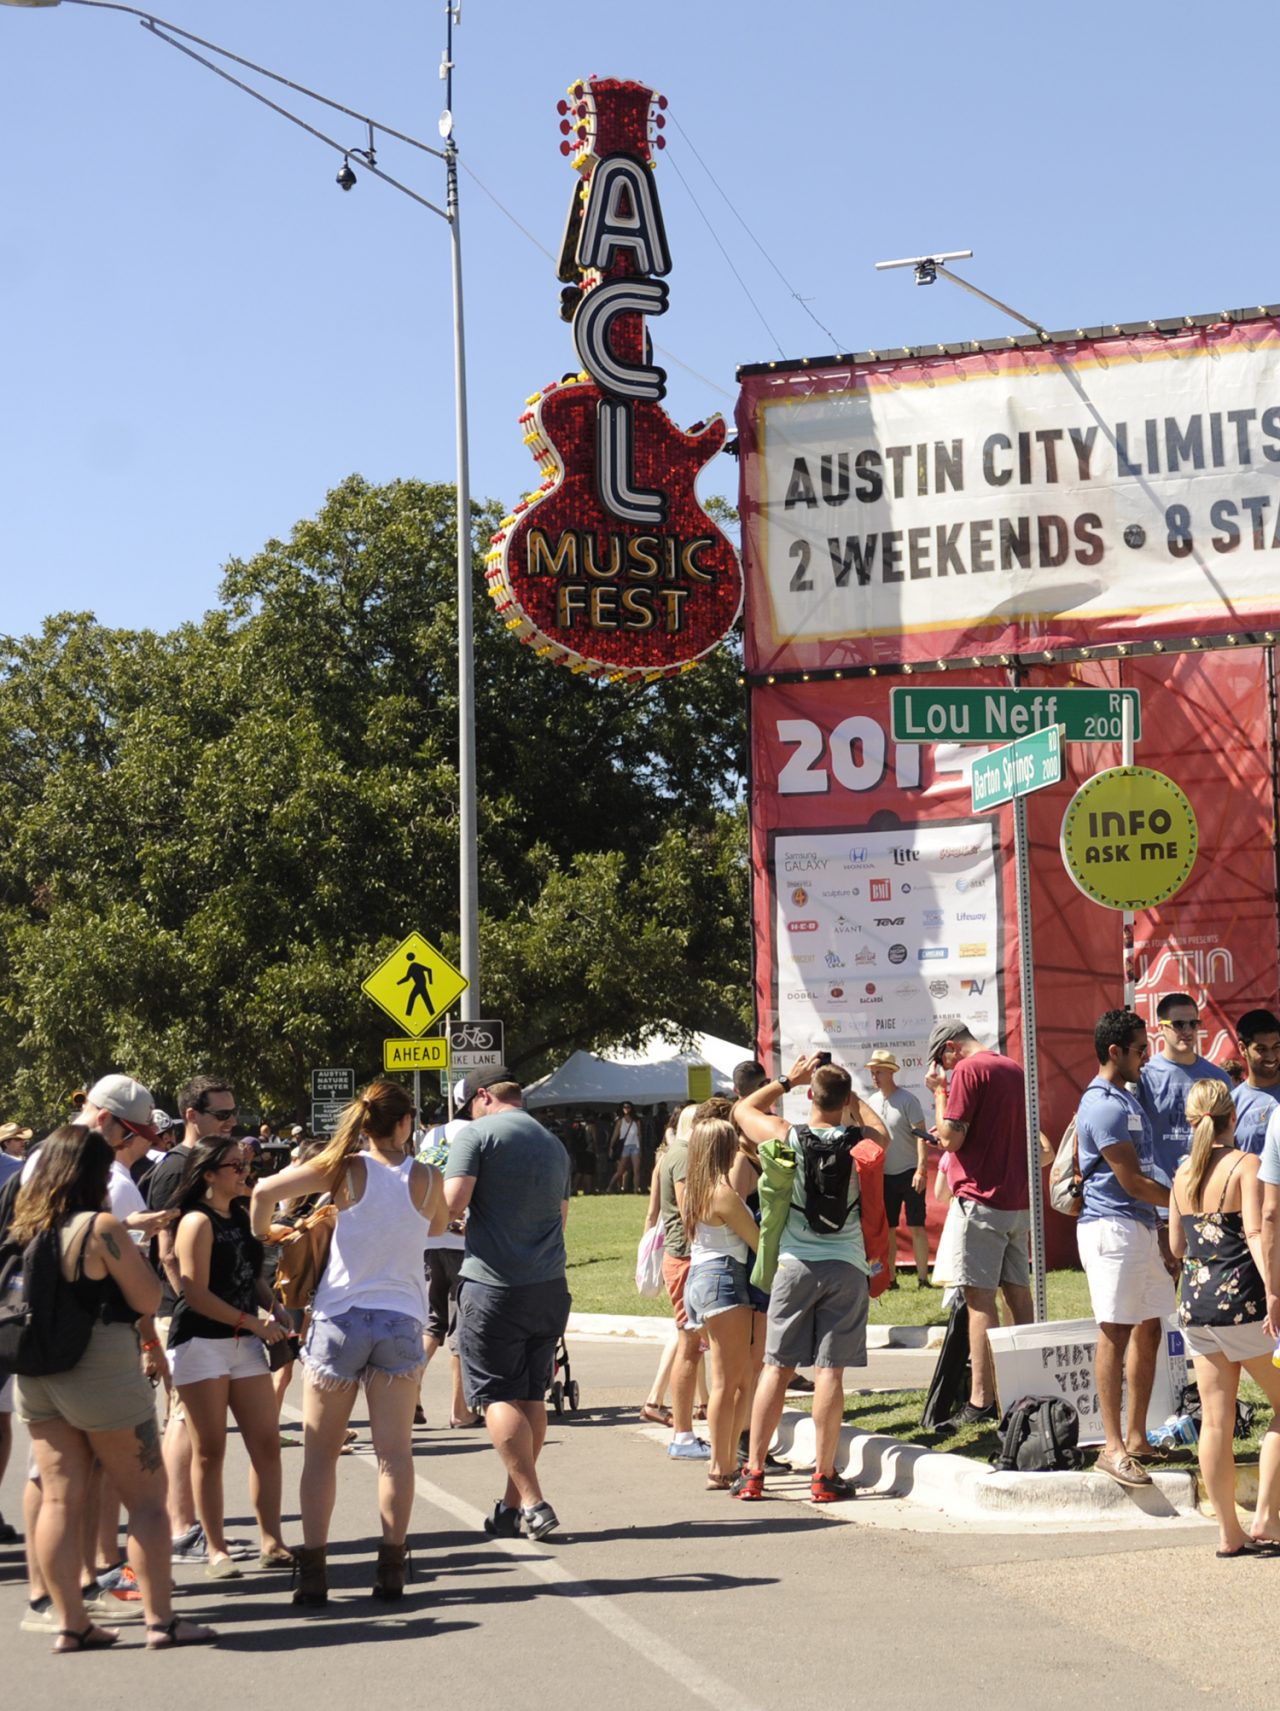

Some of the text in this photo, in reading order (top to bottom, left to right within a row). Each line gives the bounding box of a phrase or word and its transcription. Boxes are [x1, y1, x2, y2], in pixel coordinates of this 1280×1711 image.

[784, 438, 965, 511] AUSTIN
[982, 425, 1100, 487] CITY
[526, 526, 714, 583] MUSIC
[788, 539, 814, 593] 2
[827, 513, 1105, 588] WEEKENDS
[1164, 504, 1194, 559] 8
[558, 584, 690, 632] FEST
[904, 693, 1133, 734] Lou Neff R
[974, 731, 1057, 801] Barton Springs RD
[1042, 755, 1058, 780] 2000
[1089, 808, 1172, 838] INFO
[784, 851, 817, 861] Samsung
[1085, 841, 1178, 864] ASK ME
[784, 860, 828, 872] GALAXY
[834, 925, 862, 934] AVANT
[875, 1018, 896, 1030] PAIGE
[393, 1046, 441, 1062] AHEAD
[452, 1054, 497, 1065] IKE LANE
[901, 1056, 924, 1068] 101X
[1054, 1368, 1090, 1393] YES
